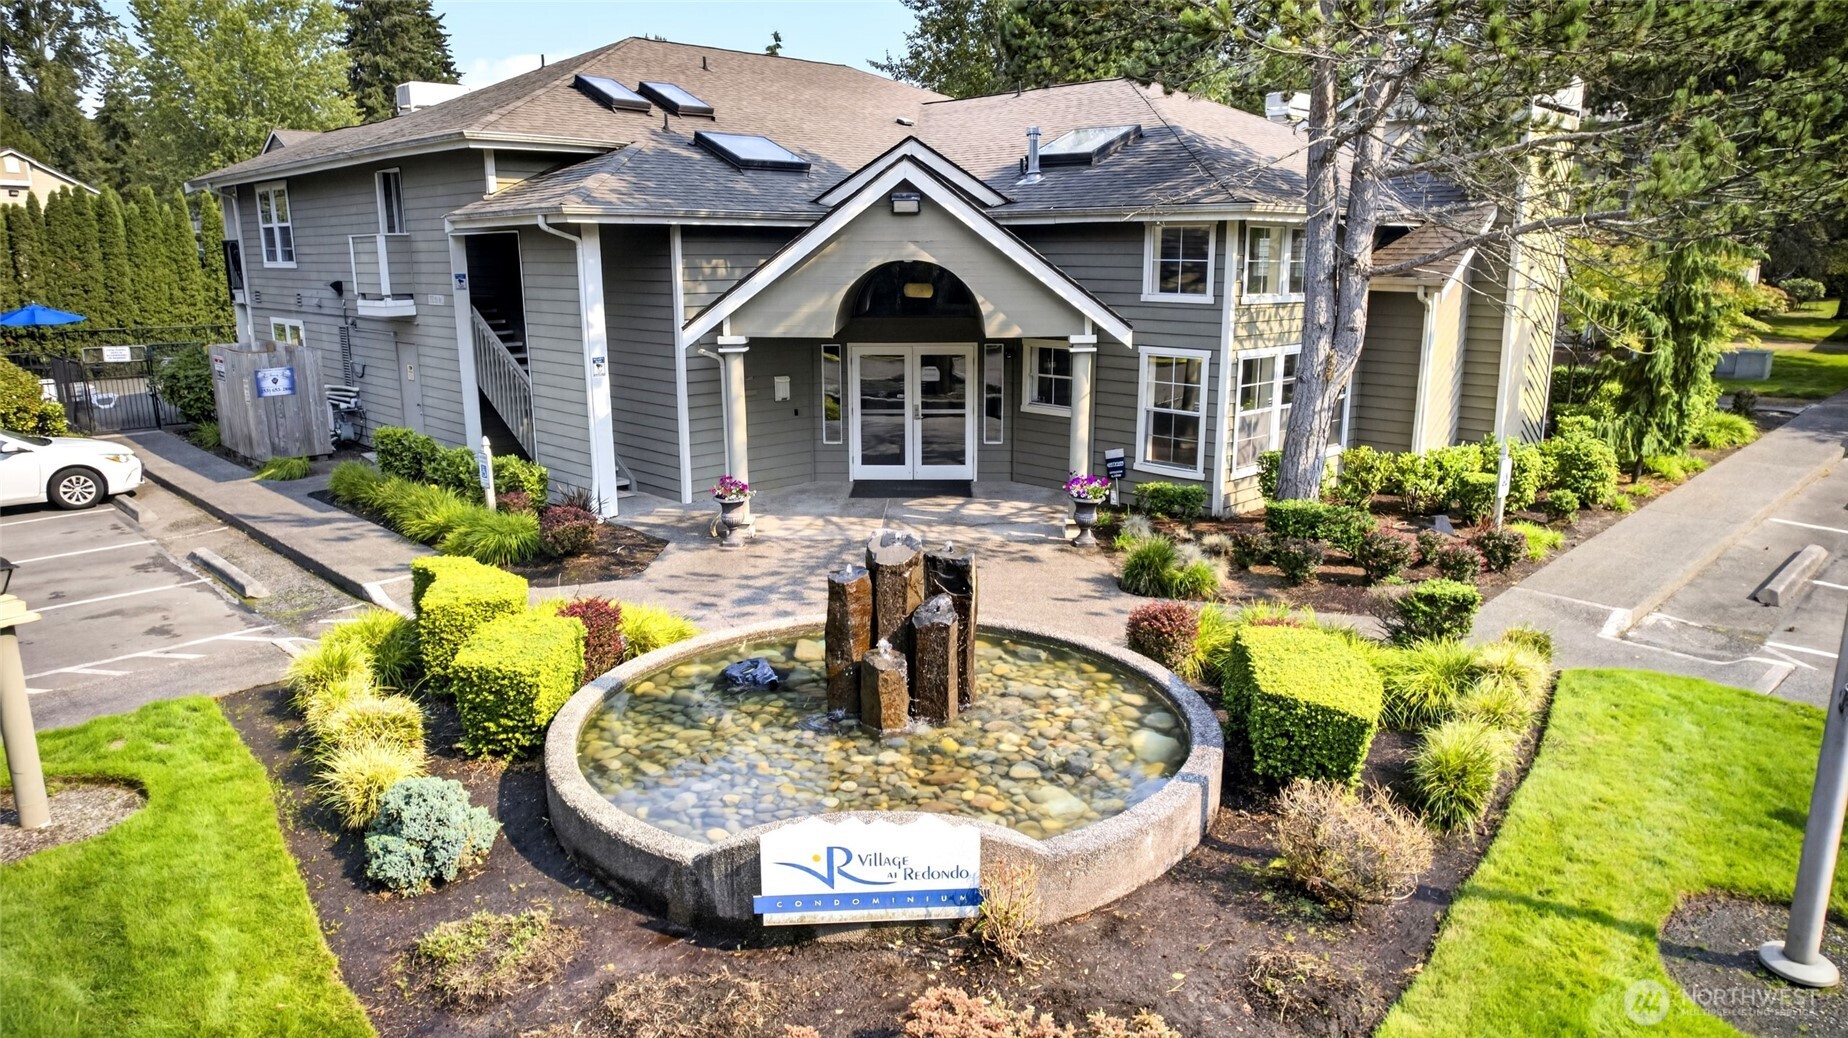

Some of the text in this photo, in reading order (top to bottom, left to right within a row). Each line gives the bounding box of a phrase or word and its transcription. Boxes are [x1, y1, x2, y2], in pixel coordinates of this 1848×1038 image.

[857, 852, 909, 869] Village
[903, 865, 970, 881] Redondo
[776, 894, 967, 908] CONDOMINIUM
